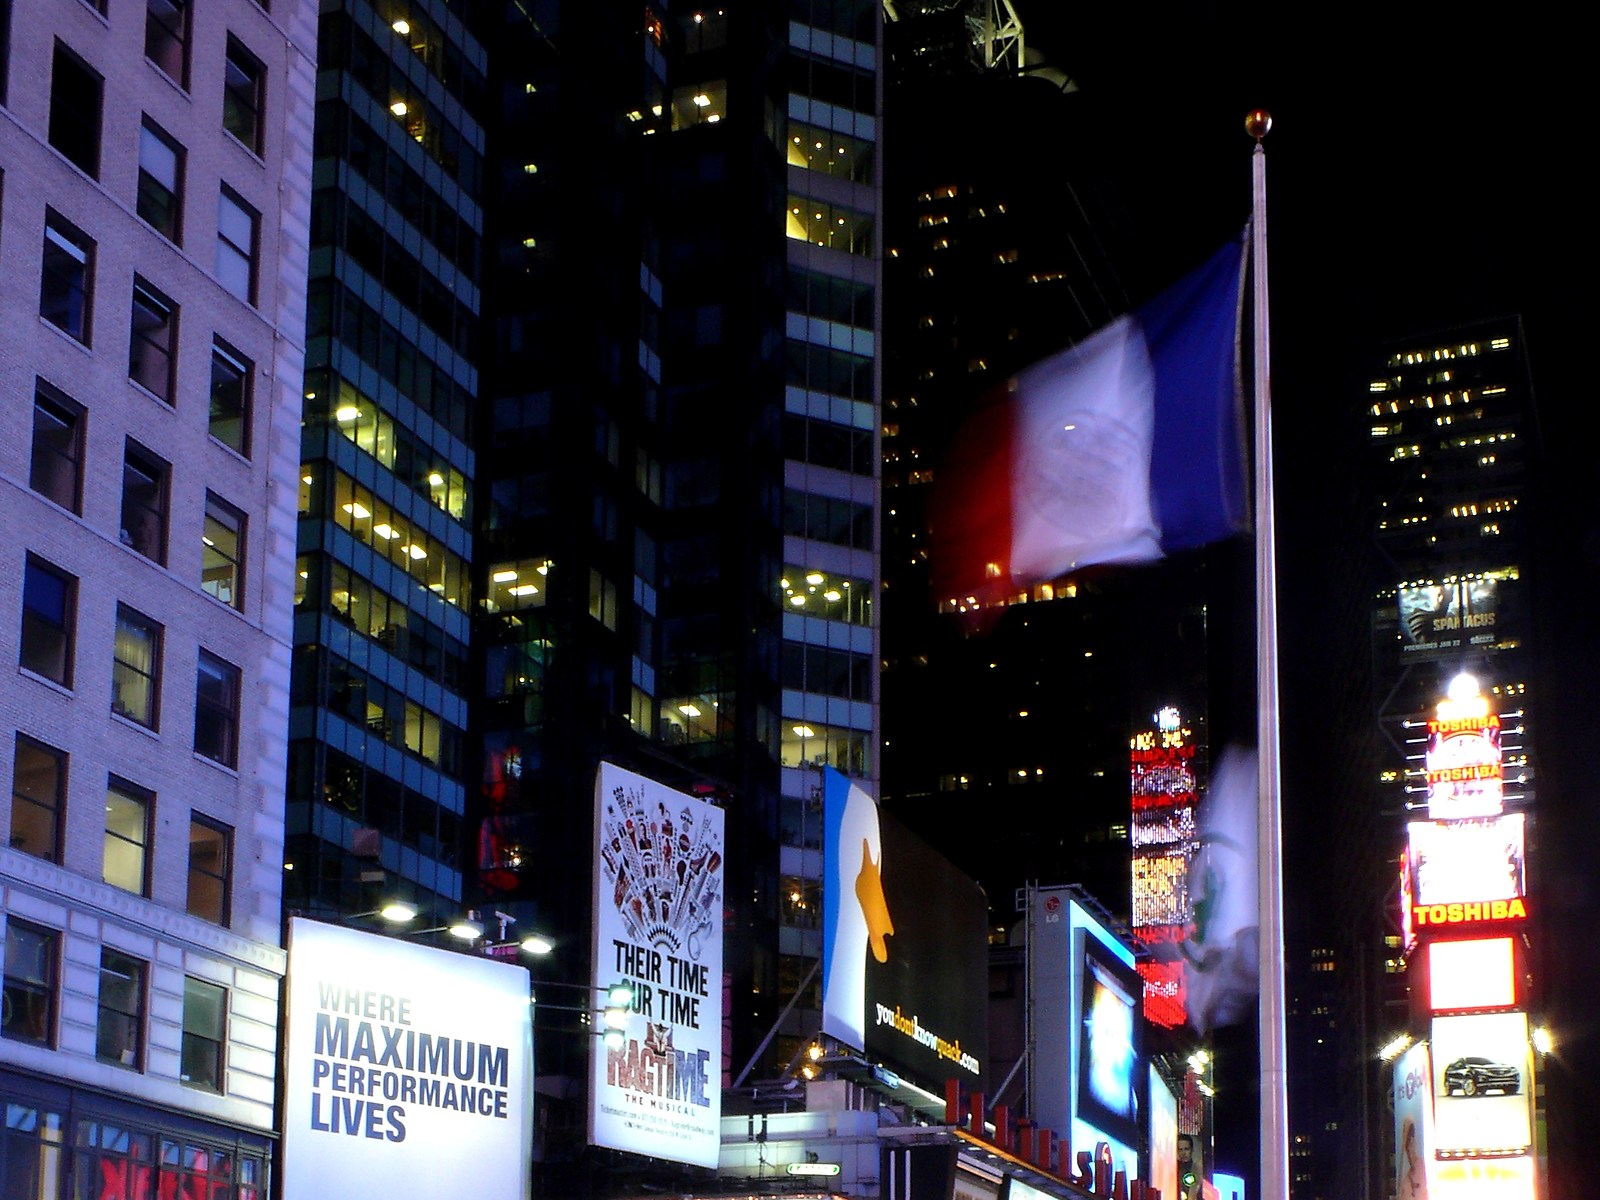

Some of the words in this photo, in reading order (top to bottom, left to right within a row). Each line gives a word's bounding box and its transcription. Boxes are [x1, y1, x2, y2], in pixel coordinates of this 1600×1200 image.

[1429, 715, 1500, 734] TOSHIBA
[1433, 764, 1500, 783] TOSHIBA
[1046, 914, 1060, 923] LG
[1414, 900, 1527, 924] TOSHIBA
[612, 939, 661, 984] THEIR
[667, 955, 709, 997] TIME
[317, 981, 411, 1025] WHERE
[658, 989, 700, 1029] TIME
[315, 1013, 509, 1088] MAXIMUM
[606, 1022, 710, 1107] RAGTIME
[313, 1058, 508, 1119] PERFORMANCE
[625, 1093, 643, 1106] THE
[650, 1099, 695, 1117] MUSICAL
[311, 1092, 406, 1143] LIVES
